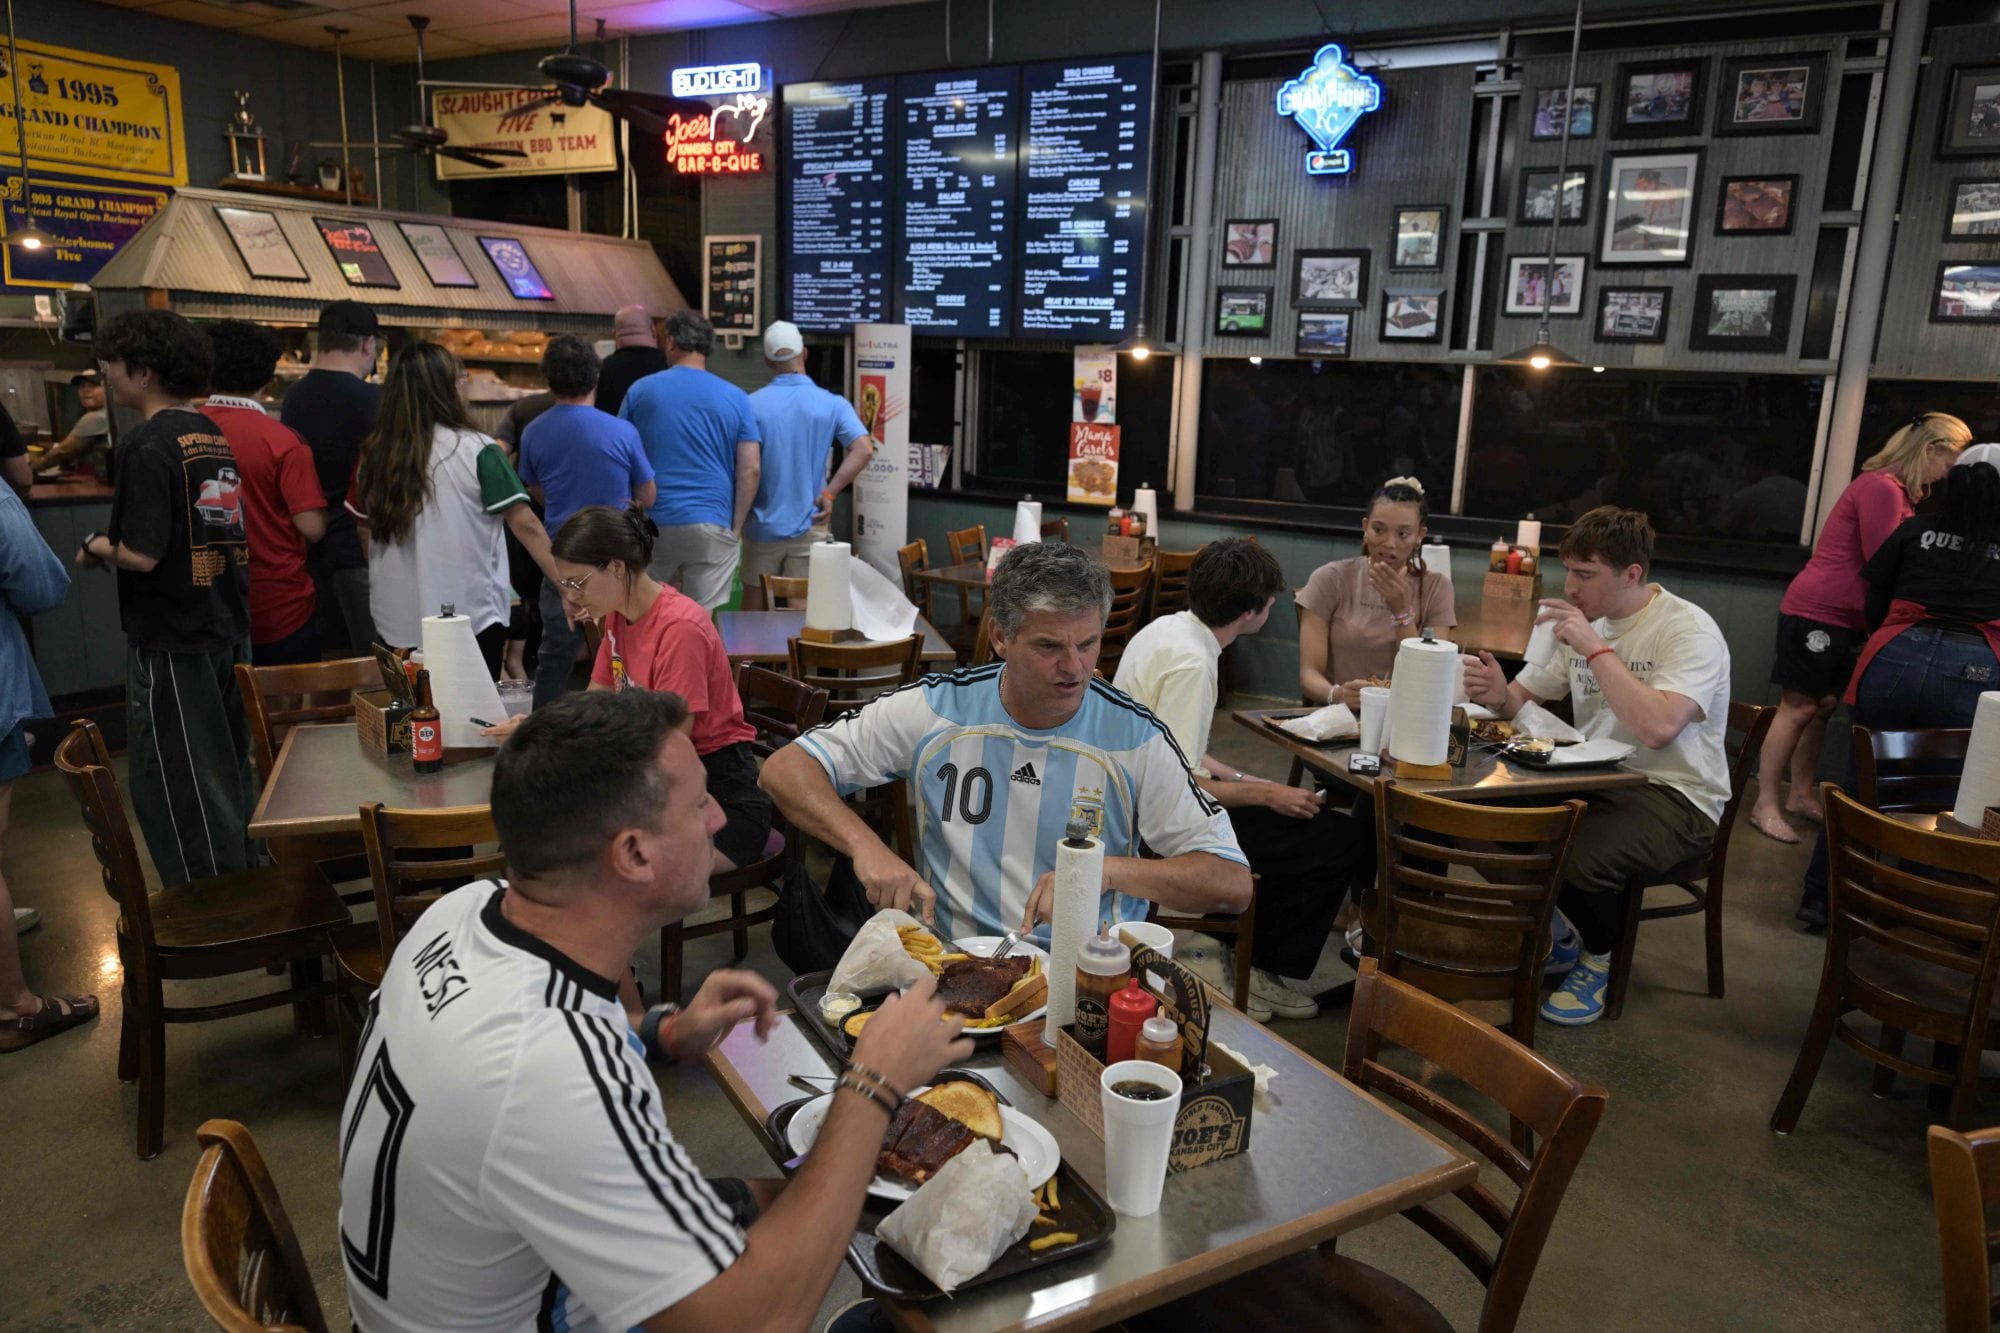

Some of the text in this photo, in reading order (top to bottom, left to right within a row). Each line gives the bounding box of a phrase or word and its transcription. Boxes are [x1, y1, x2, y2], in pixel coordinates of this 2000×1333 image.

[679, 69, 756, 91] BUD LIGHT
[57, 77, 119, 107] 1995
[73, 114, 162, 140] CHAMPION
[496, 112, 539, 134] FIVE
[1315, 108, 1338, 134] KC
[11, 126, 55, 141] Aerican
[665, 113, 711, 162] Joe's
[16, 139, 69, 155] Ivitational
[530, 138, 553, 154] BBQ
[557, 134, 597, 151] TEAM
[677, 140, 736, 156] KANSAS CITY
[677, 153, 760, 173] BAR-B-QUE
[56, 195, 96, 209] GRAND
[54, 207, 78, 220] Royal
[80, 211, 101, 222] Open
[103, 213, 139, 225] Barbecue
[56, 249, 82, 261] Five
[1062, 256, 1080, 264] JUST
[1044, 297, 1115, 306] MEAT BY THE POUND
[1098, 369, 1113, 383] $8
[1075, 425, 1113, 443] Mama
[1920, 530, 1965, 551] QUE
[1010, 773, 1041, 786] adidas
[936, 762, 994, 825] 10
[411, 930, 471, 1021] MESSI
[1176, 1103, 1230, 1128] WORLD FAMOUS
[1172, 1123, 1233, 1147] JOE'S
[1170, 1142, 1228, 1156] KANSAS CITY
